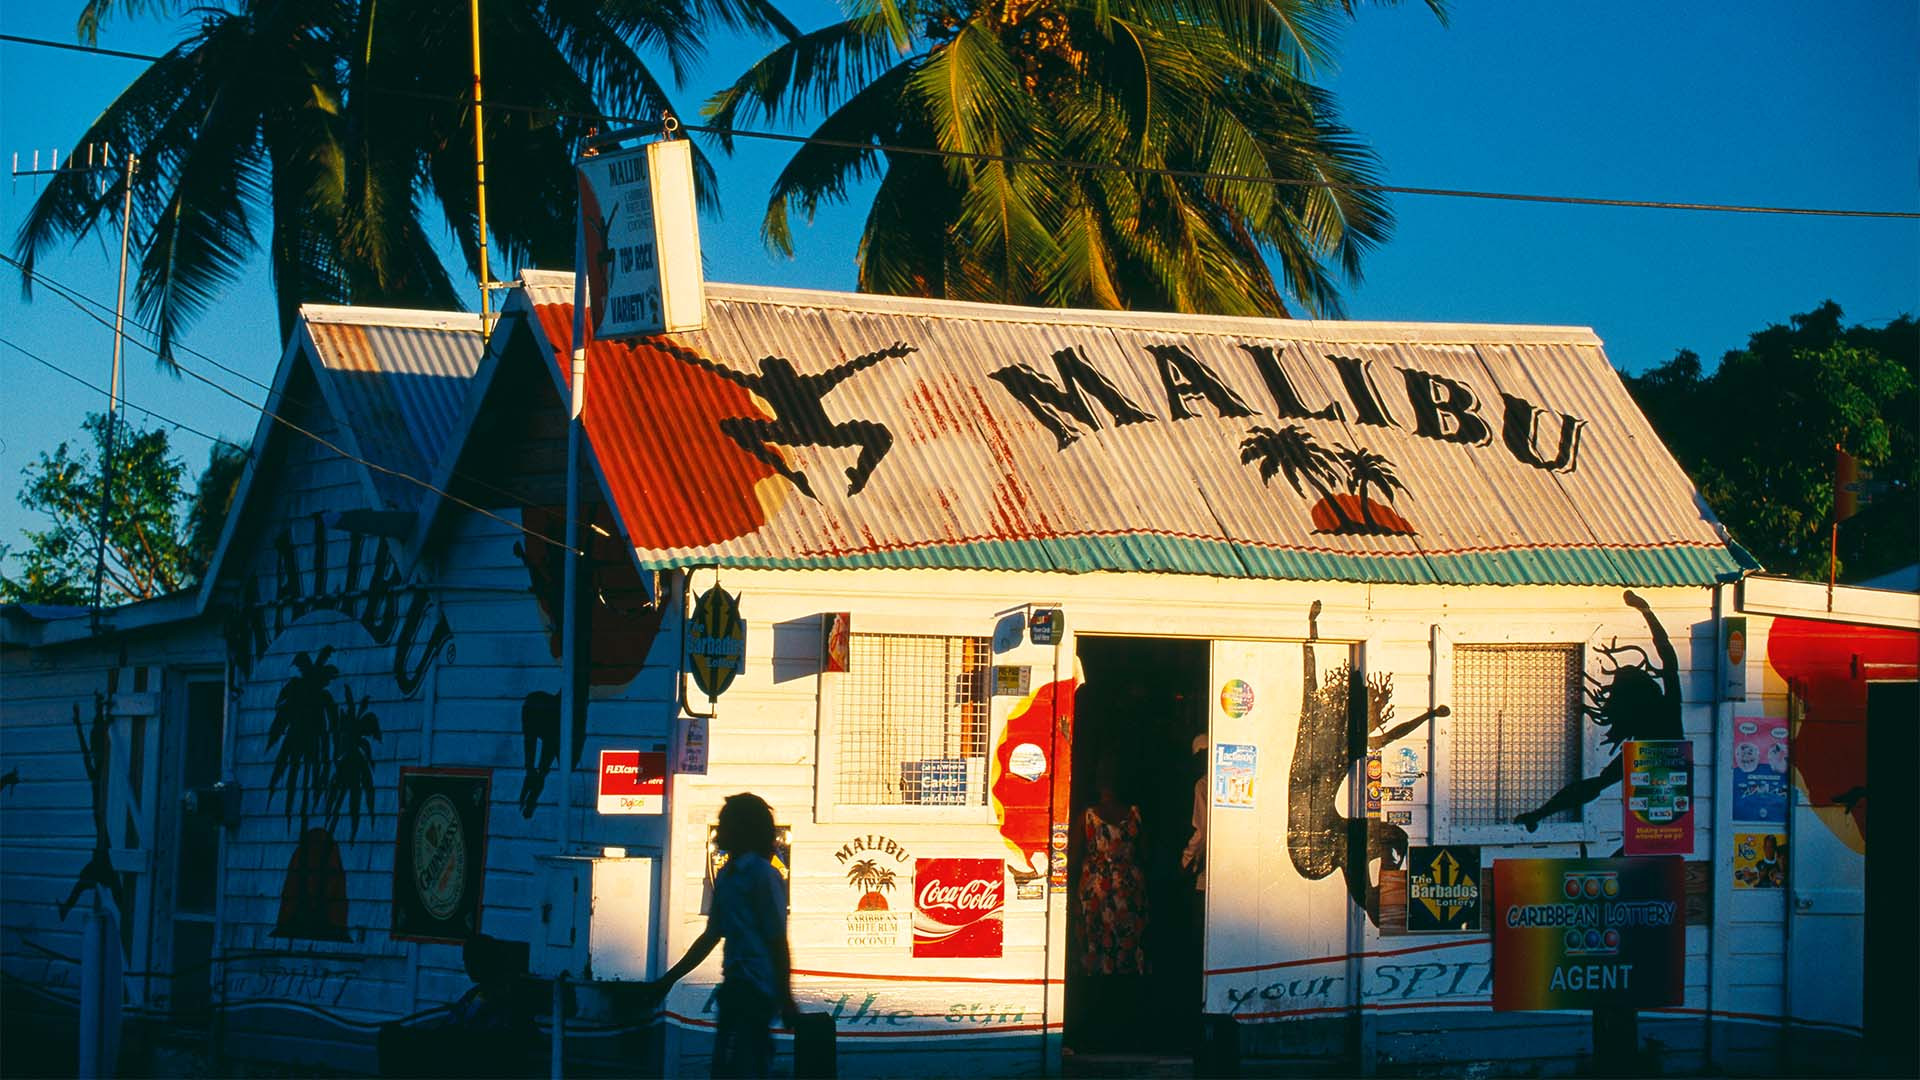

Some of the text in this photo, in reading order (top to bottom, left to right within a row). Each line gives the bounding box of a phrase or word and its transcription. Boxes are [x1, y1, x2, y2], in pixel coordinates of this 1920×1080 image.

[608, 157, 647, 187] MALIBU
[620, 243, 654, 274] TOP ROCK
[610, 293, 645, 324] VARIETY
[988, 344, 1588, 474] MALIBU
[922, 775, 961, 788] Cards
[834, 834, 909, 864] MALIBU
[1411, 875, 1433, 885] The
[1411, 884, 1478, 898] Barbados
[918, 879, 1003, 910] Coca-Cola
[1435, 898, 1476, 908] Lottery
[847, 922, 898, 934] WHITE RUM
[1506, 901, 1676, 928] CARIBBEAN LOTTERY
[847, 935, 897, 946] COCONUT
[1228, 960, 1494, 1016] your SPI
[1549, 964, 1633, 992] AGENT
